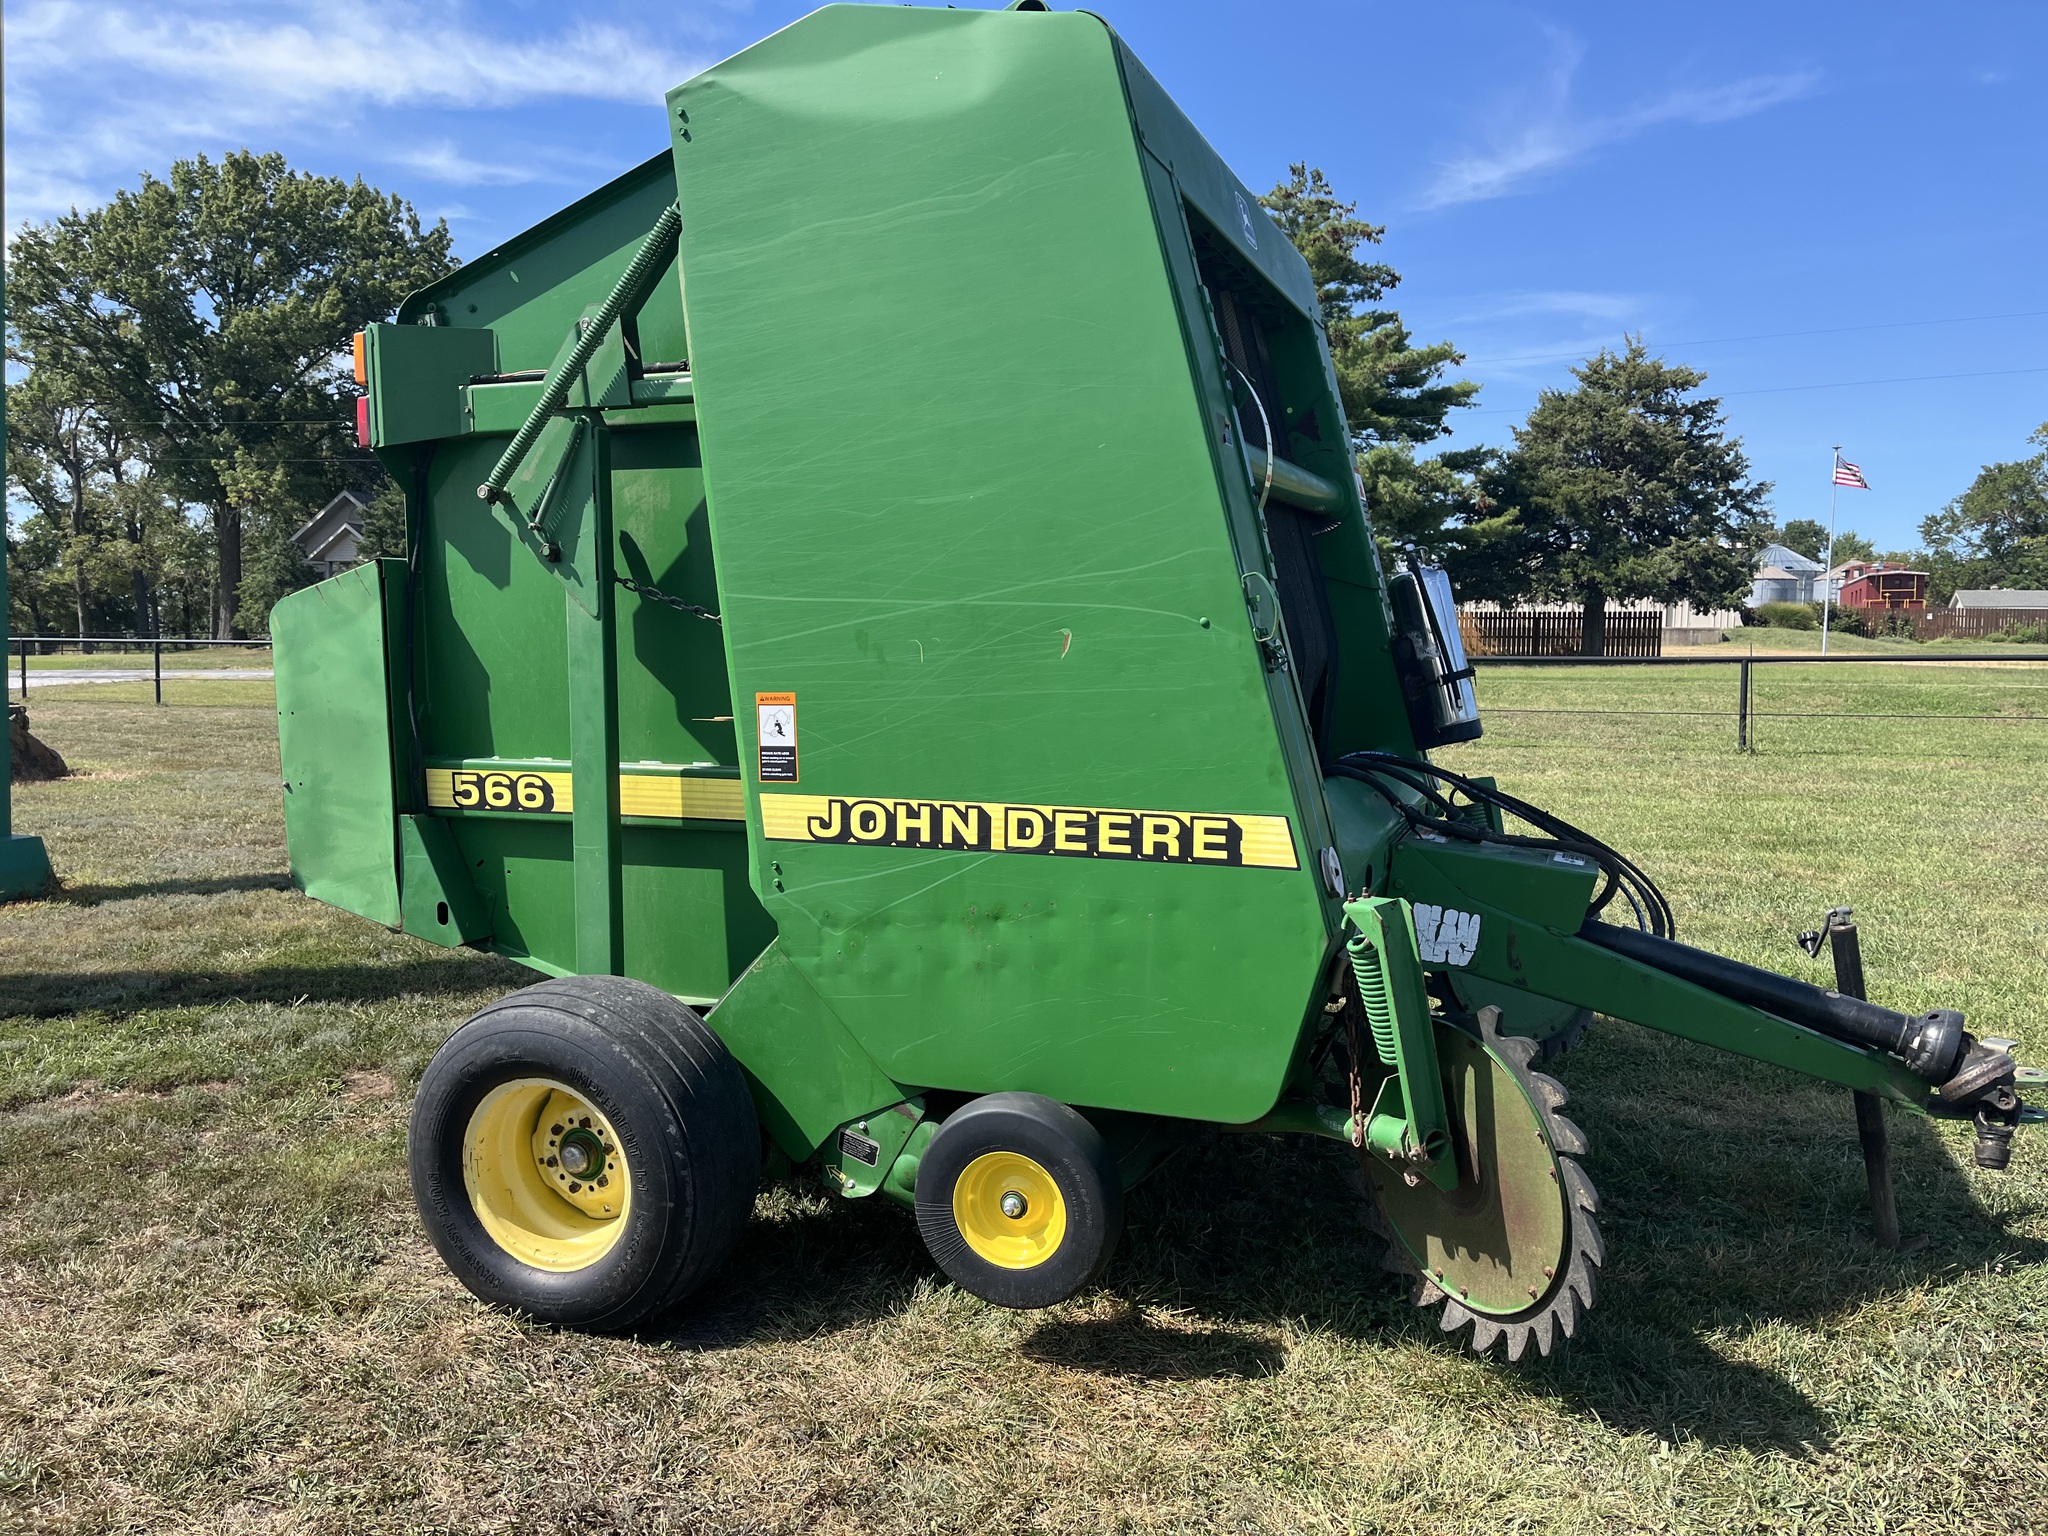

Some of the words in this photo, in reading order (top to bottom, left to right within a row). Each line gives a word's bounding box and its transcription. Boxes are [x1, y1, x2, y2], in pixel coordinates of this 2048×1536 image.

[452, 772, 553, 811] 566
[808, 799, 984, 848] JOHN
[1004, 806, 1238, 863] DEERE
[568, 1066, 643, 1159] IMPLEMENT
[426, 1171, 450, 1219] KING
